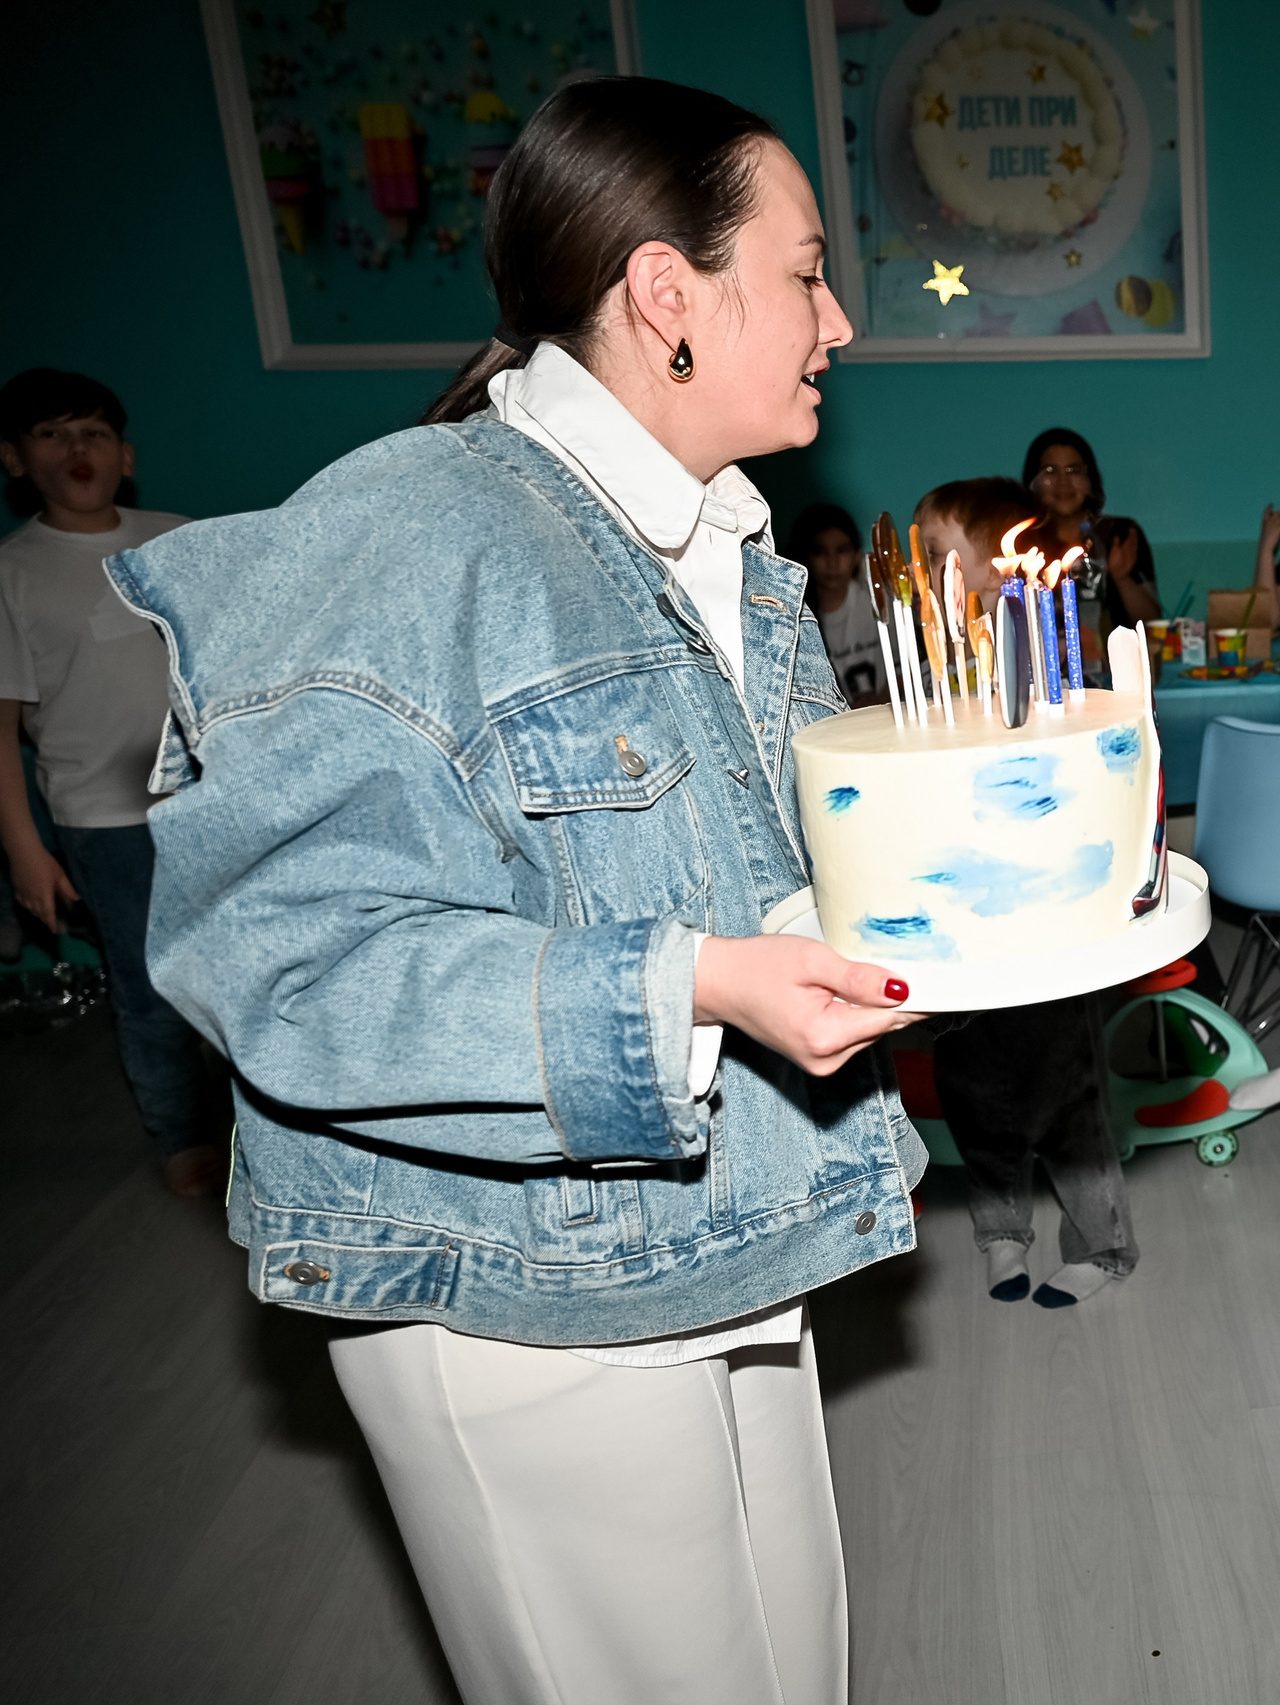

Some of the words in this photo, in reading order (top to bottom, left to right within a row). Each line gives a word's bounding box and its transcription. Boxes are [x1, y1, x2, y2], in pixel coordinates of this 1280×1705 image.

[957, 96, 1021, 131] ДЕТИ
[1029, 95, 1076, 127] ПРИ
[988, 145, 1051, 180] ДЕЛЕ
